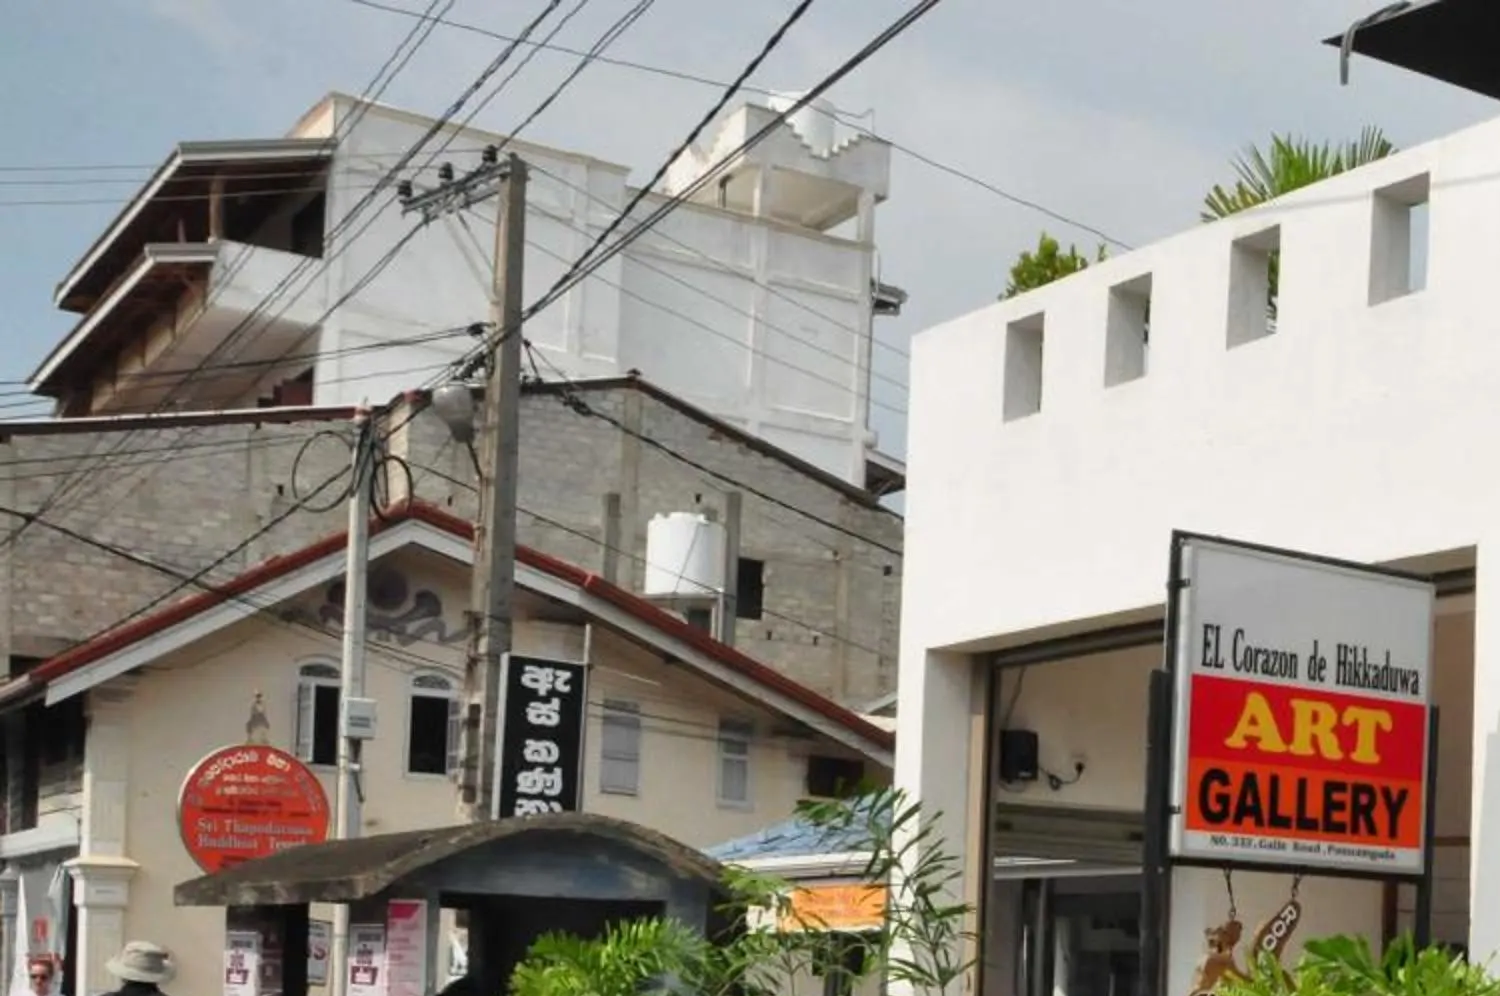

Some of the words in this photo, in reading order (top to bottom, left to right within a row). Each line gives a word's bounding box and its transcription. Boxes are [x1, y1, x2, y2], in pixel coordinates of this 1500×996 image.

[1201, 624, 1224, 669] EL
[1232, 628, 1299, 679] Corazon
[1307, 640, 1327, 684] de
[1336, 643, 1420, 695] Hikkaduwa
[1223, 691, 1394, 765] ART
[1197, 768, 1409, 840] GALLERY
